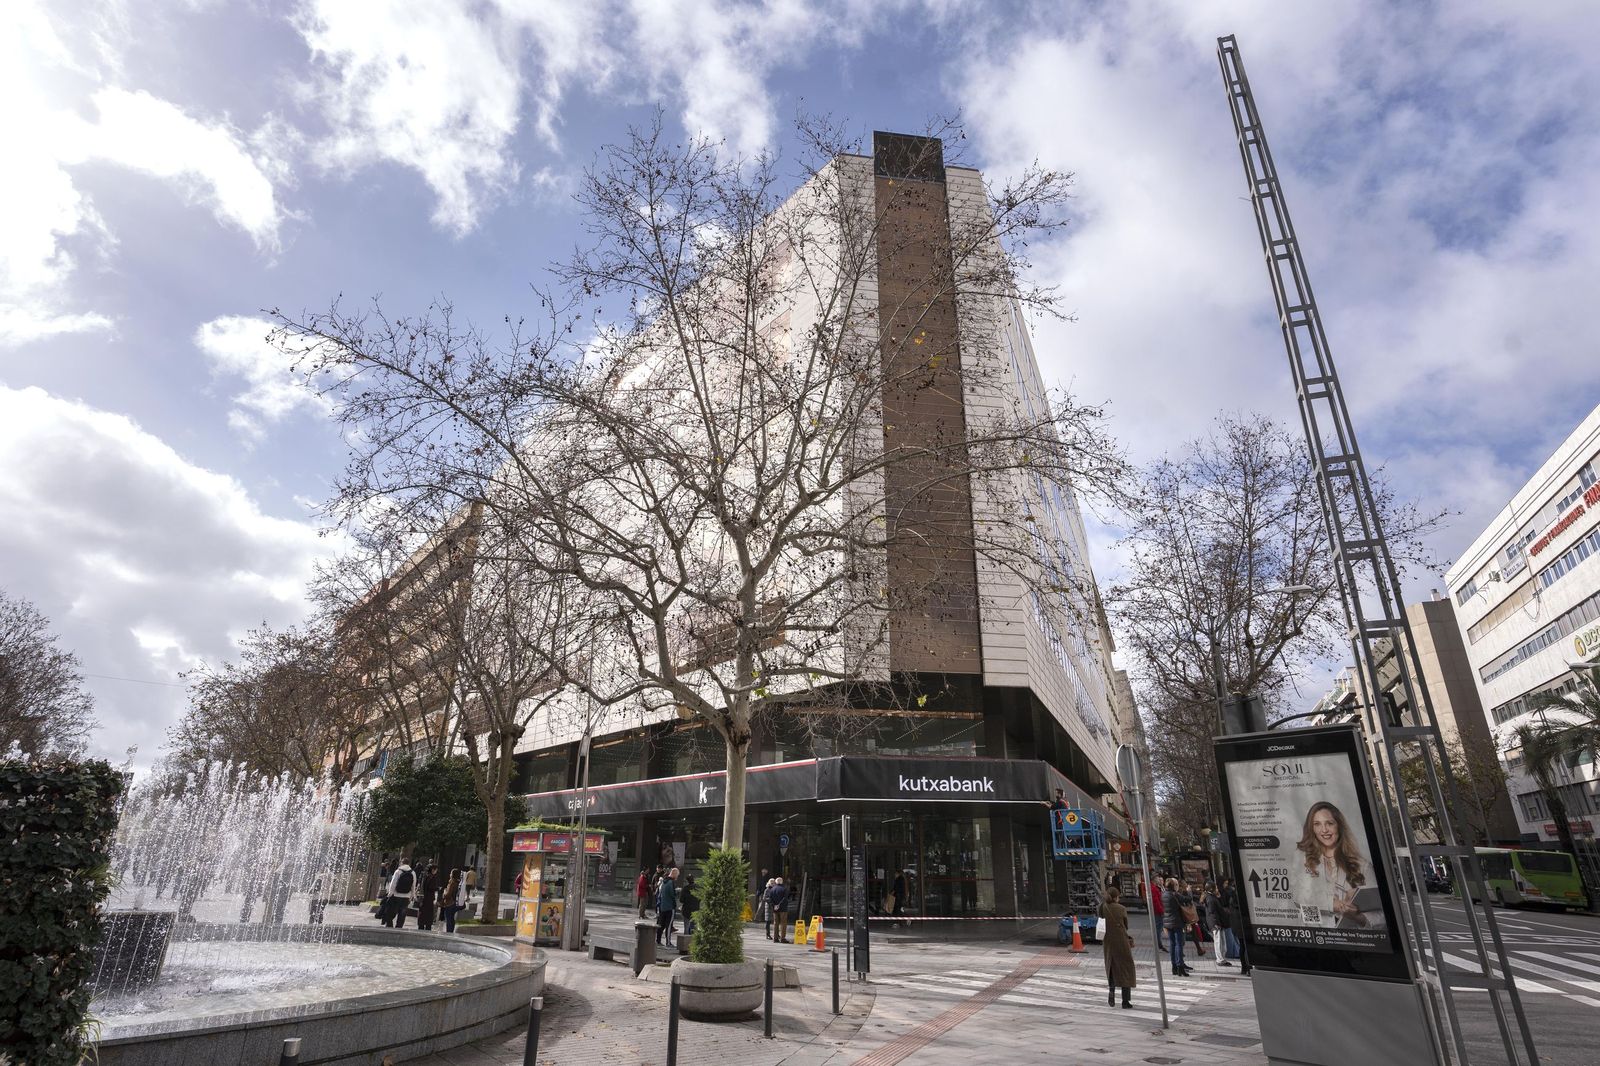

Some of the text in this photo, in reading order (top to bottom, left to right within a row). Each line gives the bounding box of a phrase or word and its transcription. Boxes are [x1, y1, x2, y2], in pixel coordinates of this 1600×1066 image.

[1266, 744, 1295, 752] JCDecaux
[1262, 763, 1310, 777] SOUL
[899, 775, 994, 793] kutxabank
[567, 797, 590, 812] cajasr
[1262, 876, 1289, 891] 120
[1256, 927, 1311, 938] 654 730 730
